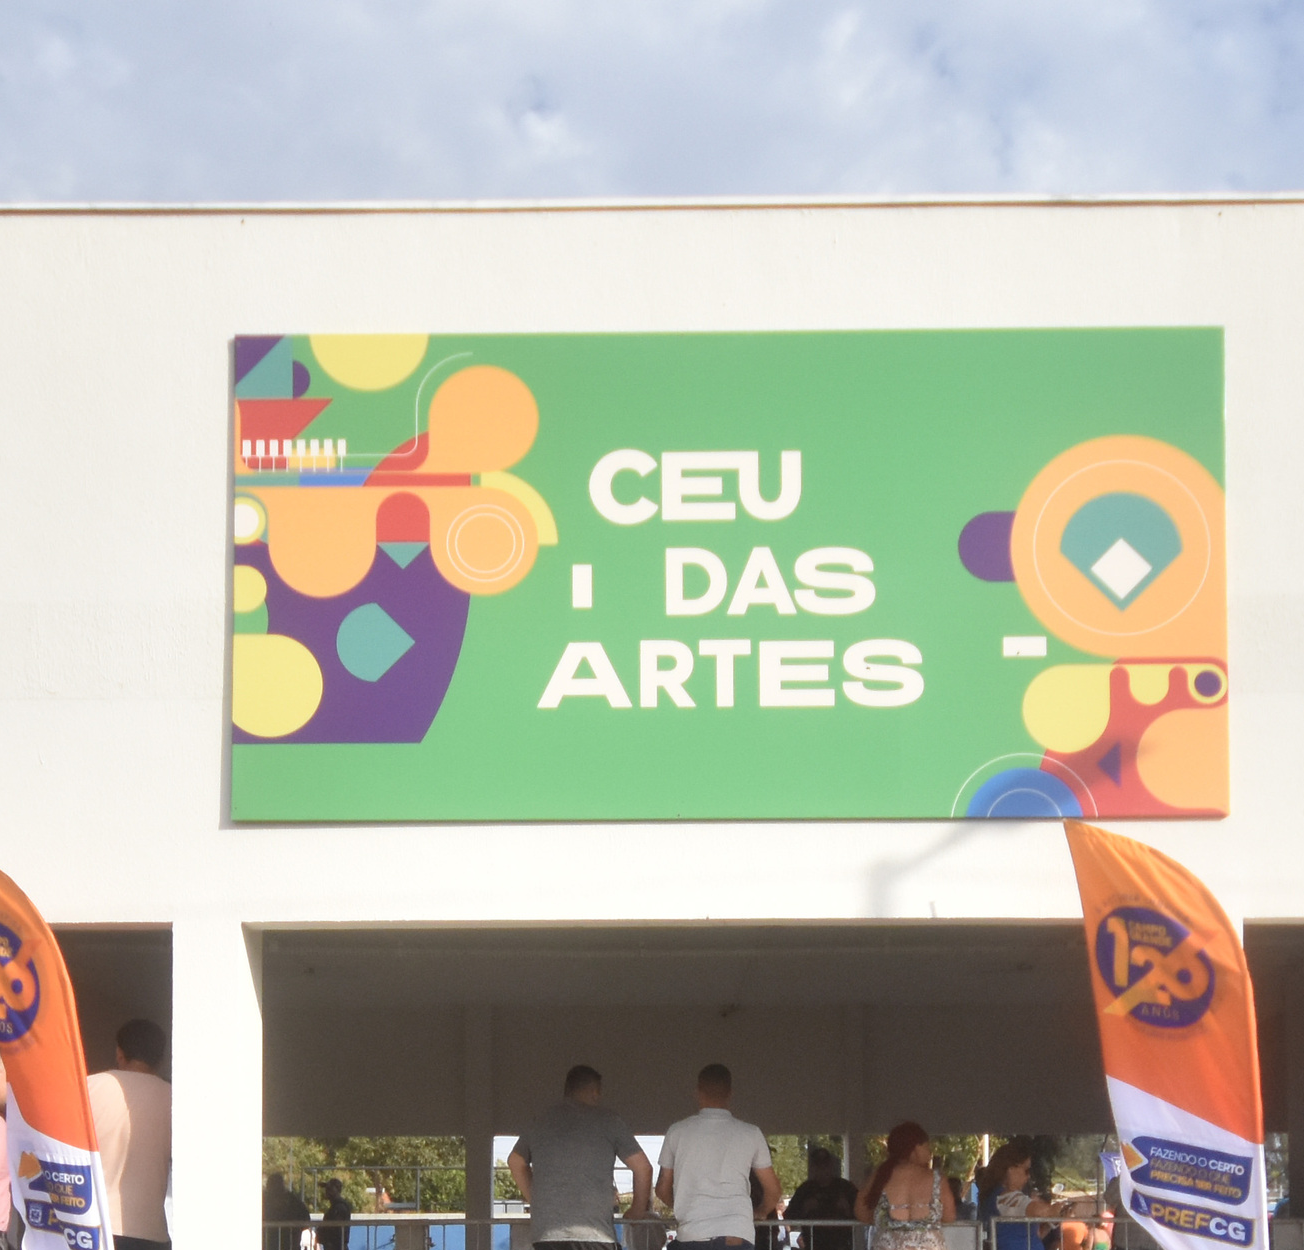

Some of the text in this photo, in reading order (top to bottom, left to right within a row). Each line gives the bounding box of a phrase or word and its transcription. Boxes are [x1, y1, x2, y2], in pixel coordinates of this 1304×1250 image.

[588, 448, 802, 526] CEU
[665, 546, 876, 616] DAS
[536, 638, 925, 710] ARTES
[1103, 917, 1216, 1016] 126
[52, 1173, 85, 1185] CERTO
[1150, 1146, 1245, 1176] FAZENDO O CERTO
[1150, 1203, 1246, 1241] PREFCG
